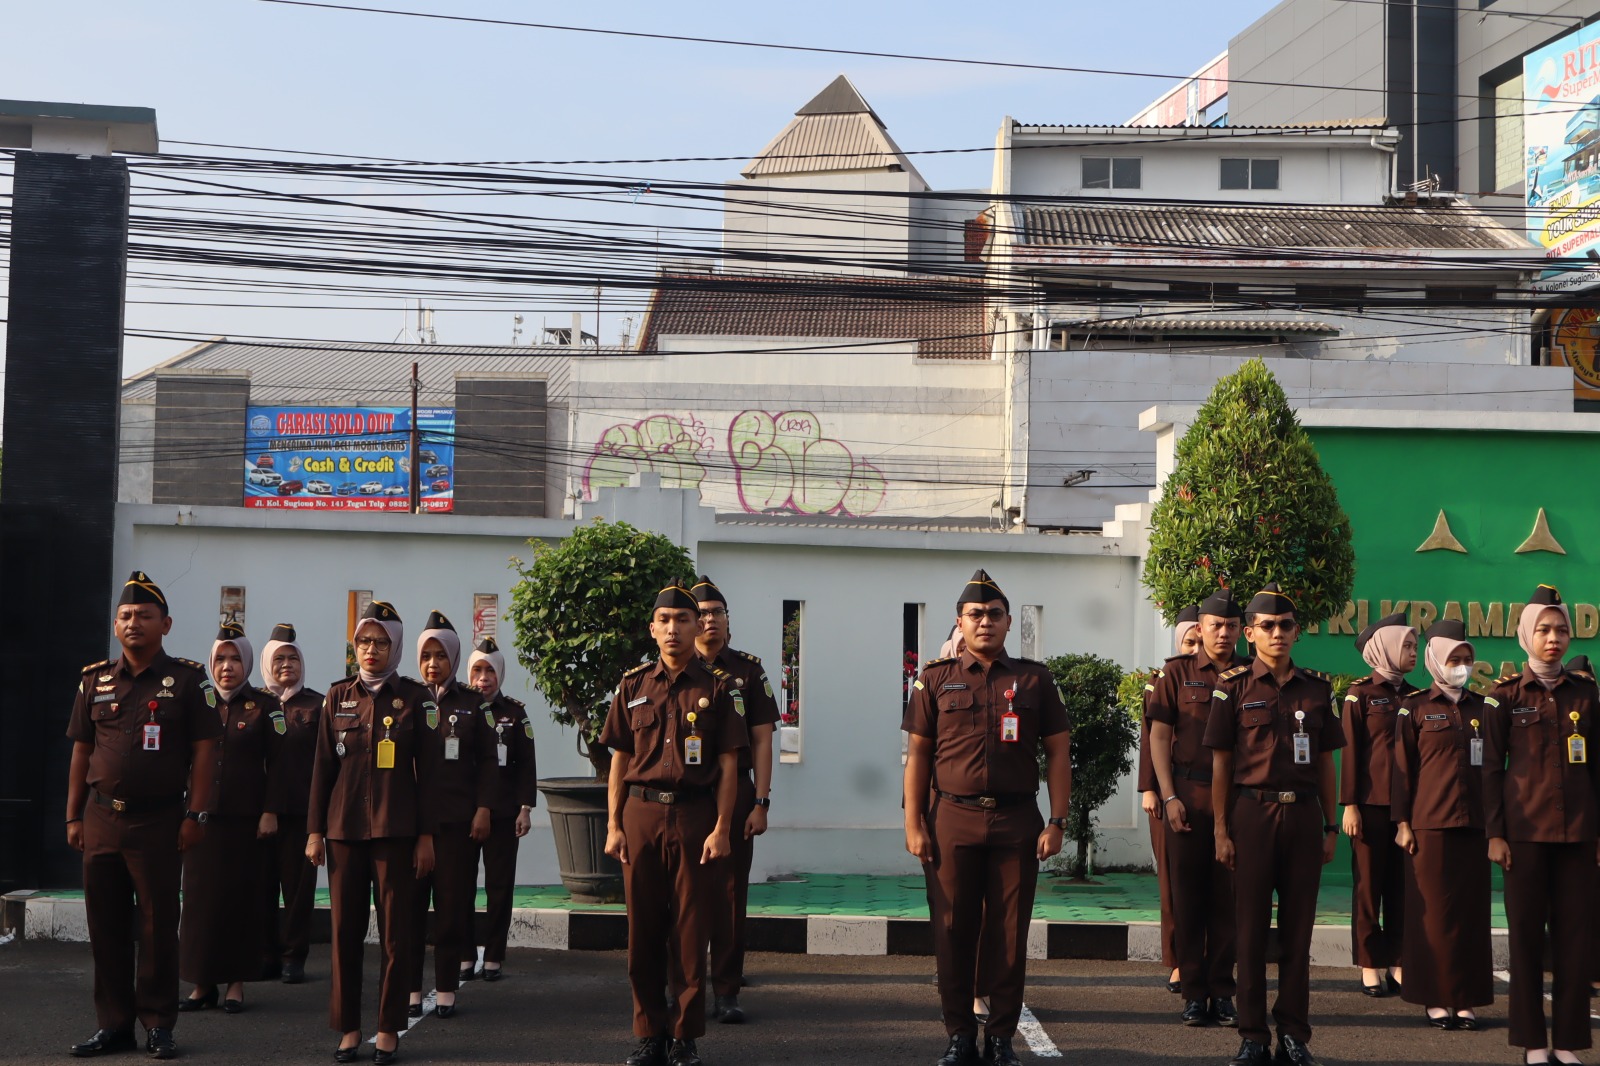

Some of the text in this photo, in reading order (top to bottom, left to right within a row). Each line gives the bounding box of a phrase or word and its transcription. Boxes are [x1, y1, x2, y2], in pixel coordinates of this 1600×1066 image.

[1549, 191, 1573, 214] ENJOY
[1547, 213, 1574, 241] YOUR
[1545, 279, 1569, 292] Kolonel
[1569, 272, 1596, 286] Sugiono
[276, 412, 395, 436] GARASI SOLD OUT
[267, 439, 313, 452] MENERIMA
[313, 439, 333, 452] JUAL
[334, 439, 352, 452] BELI
[353, 439, 379, 452] MOBIL
[303, 455, 395, 473] Cash & Credit
[283, 500, 314, 508] Sugiono
[347, 500, 367, 509] Tegal
[369, 500, 387, 509] Telp.
